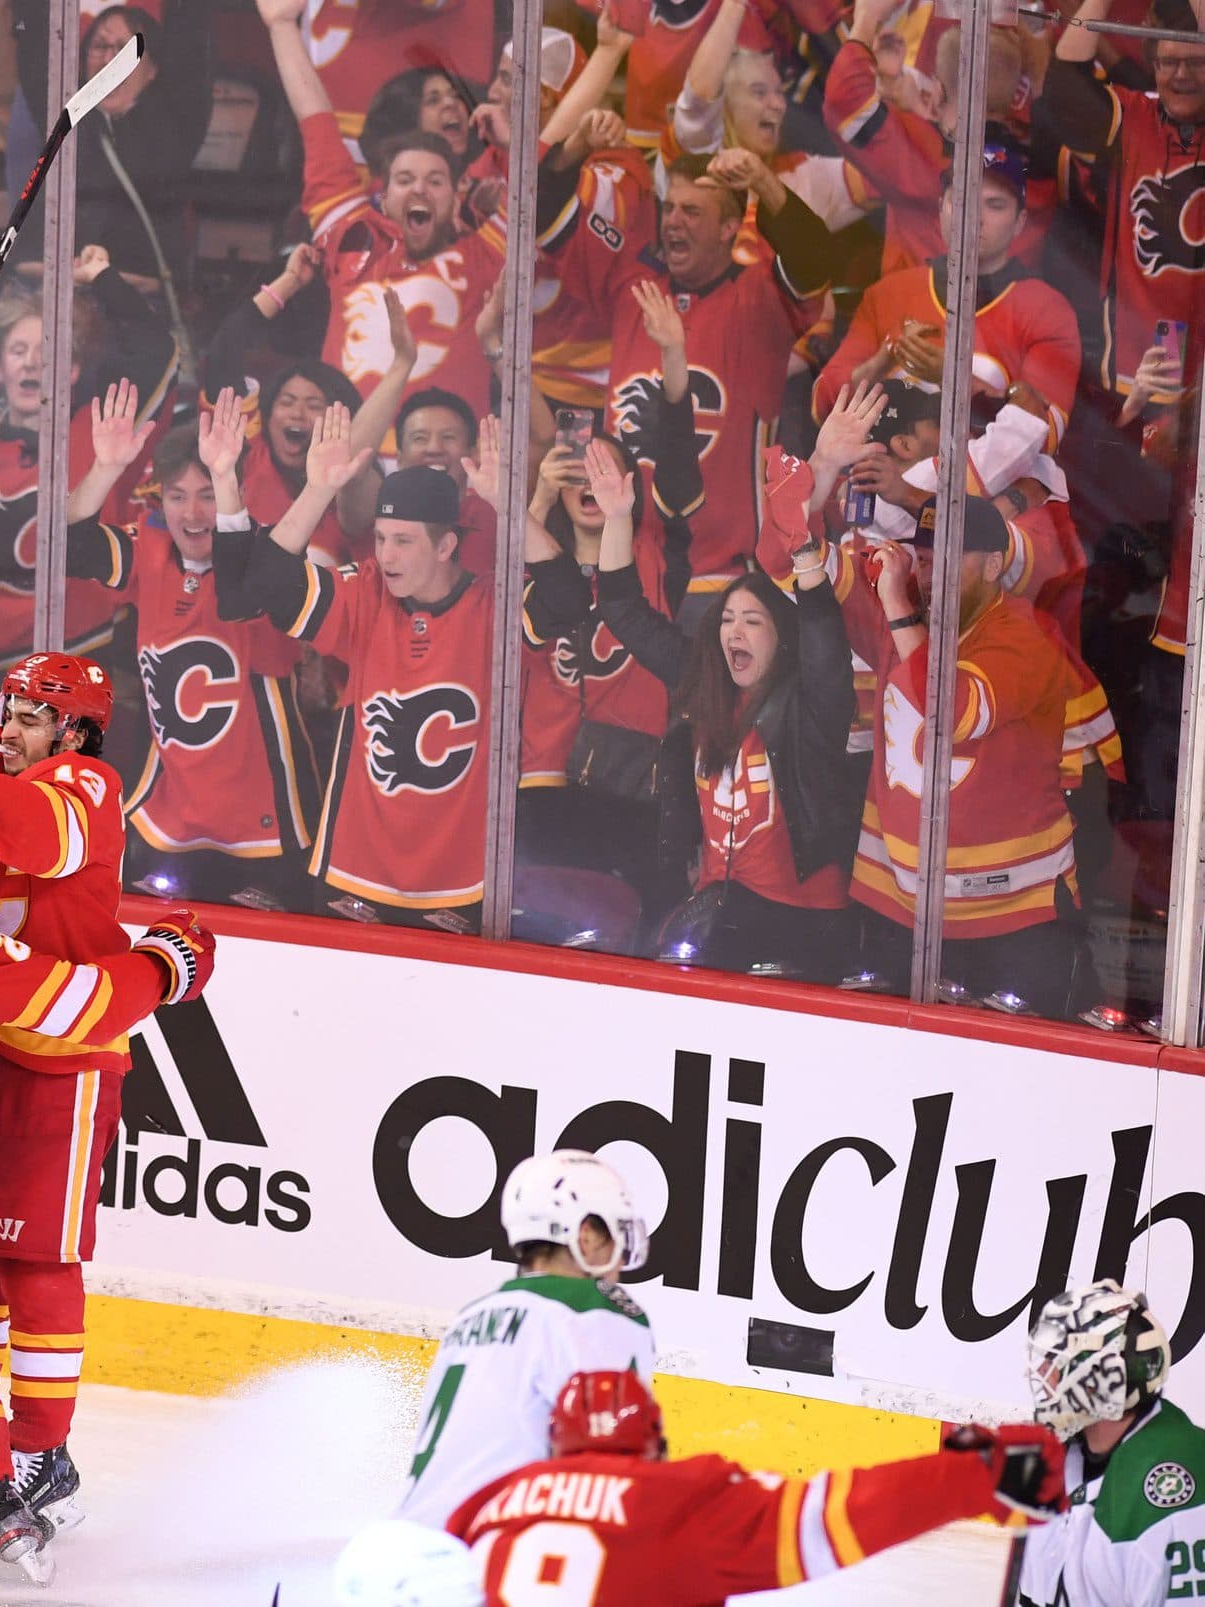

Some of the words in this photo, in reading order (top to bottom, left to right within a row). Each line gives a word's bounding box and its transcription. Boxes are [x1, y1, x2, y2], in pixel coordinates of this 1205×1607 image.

[435, 251, 468, 291] C
[138, 635, 242, 751] C
[362, 681, 480, 797] C
[54, 764, 107, 809] 13
[98, 1127, 311, 1232] idas
